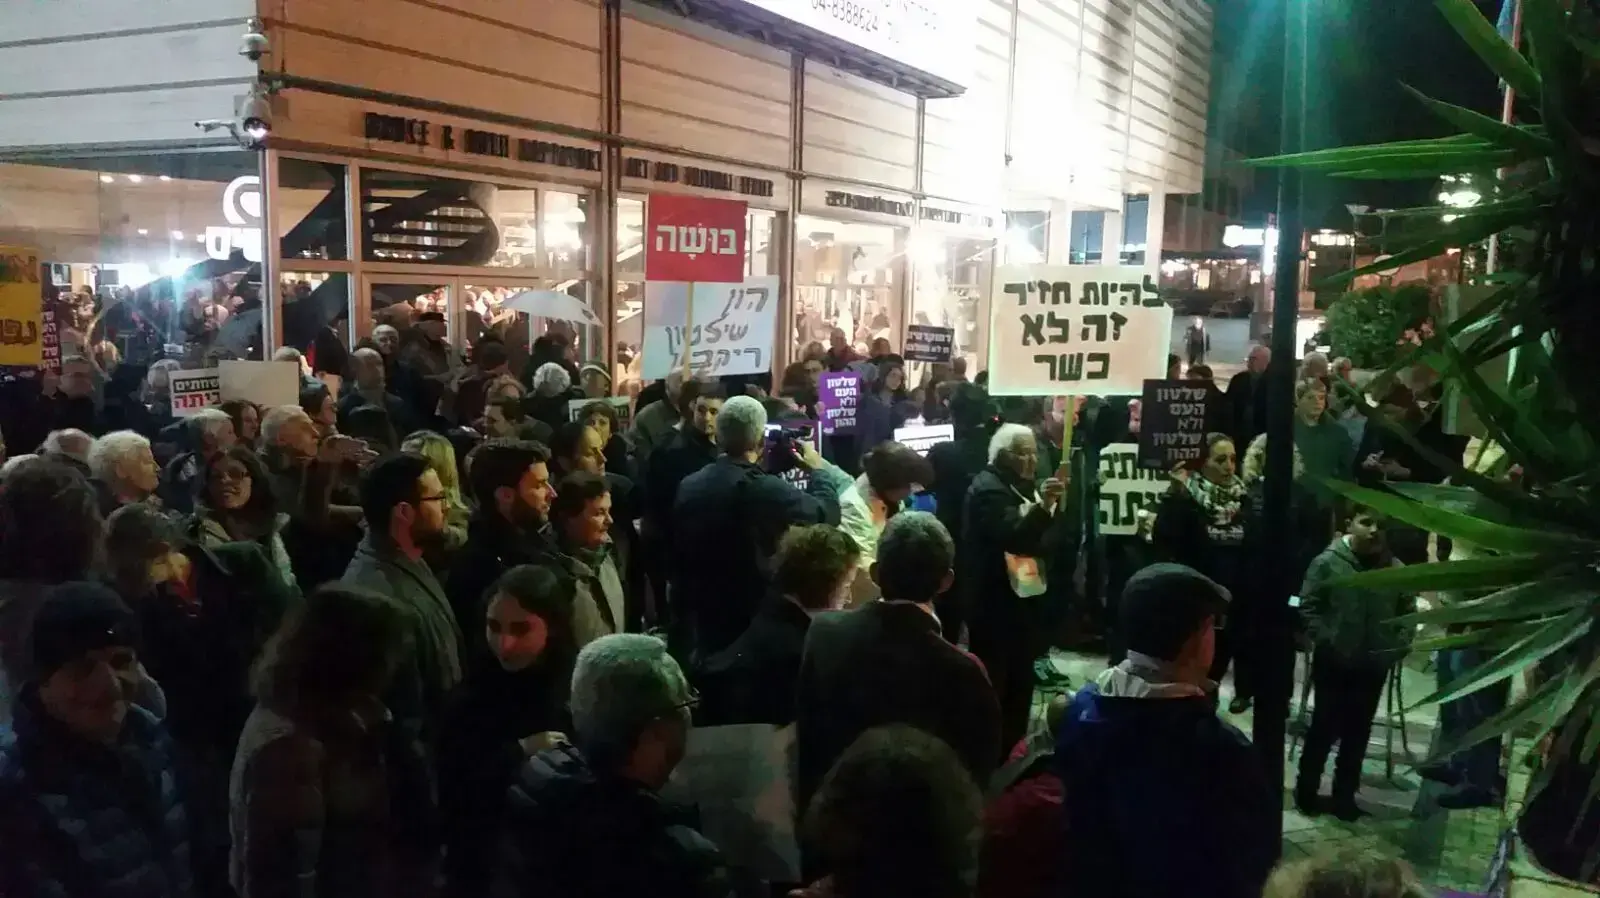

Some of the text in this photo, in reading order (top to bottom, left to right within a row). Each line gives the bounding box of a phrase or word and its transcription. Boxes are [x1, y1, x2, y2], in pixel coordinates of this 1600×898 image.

[1004, 275, 1165, 307] להיות חזיר
[720, 287, 769, 321] הון
[1020, 310, 1128, 346] זה לא
[1033, 352, 1110, 381] כשר
[827, 376, 857, 389] שלטון
[835, 388, 857, 398] העם
[1156, 386, 1207, 402] שלטון
[839, 398, 857, 407] ולא
[1168, 402, 1206, 416] העם
[827, 407, 857, 420] שלטון
[1177, 417, 1205, 431] ולא
[1152, 430, 1203, 447] שלטון
[1165, 447, 1201, 460] ההון
